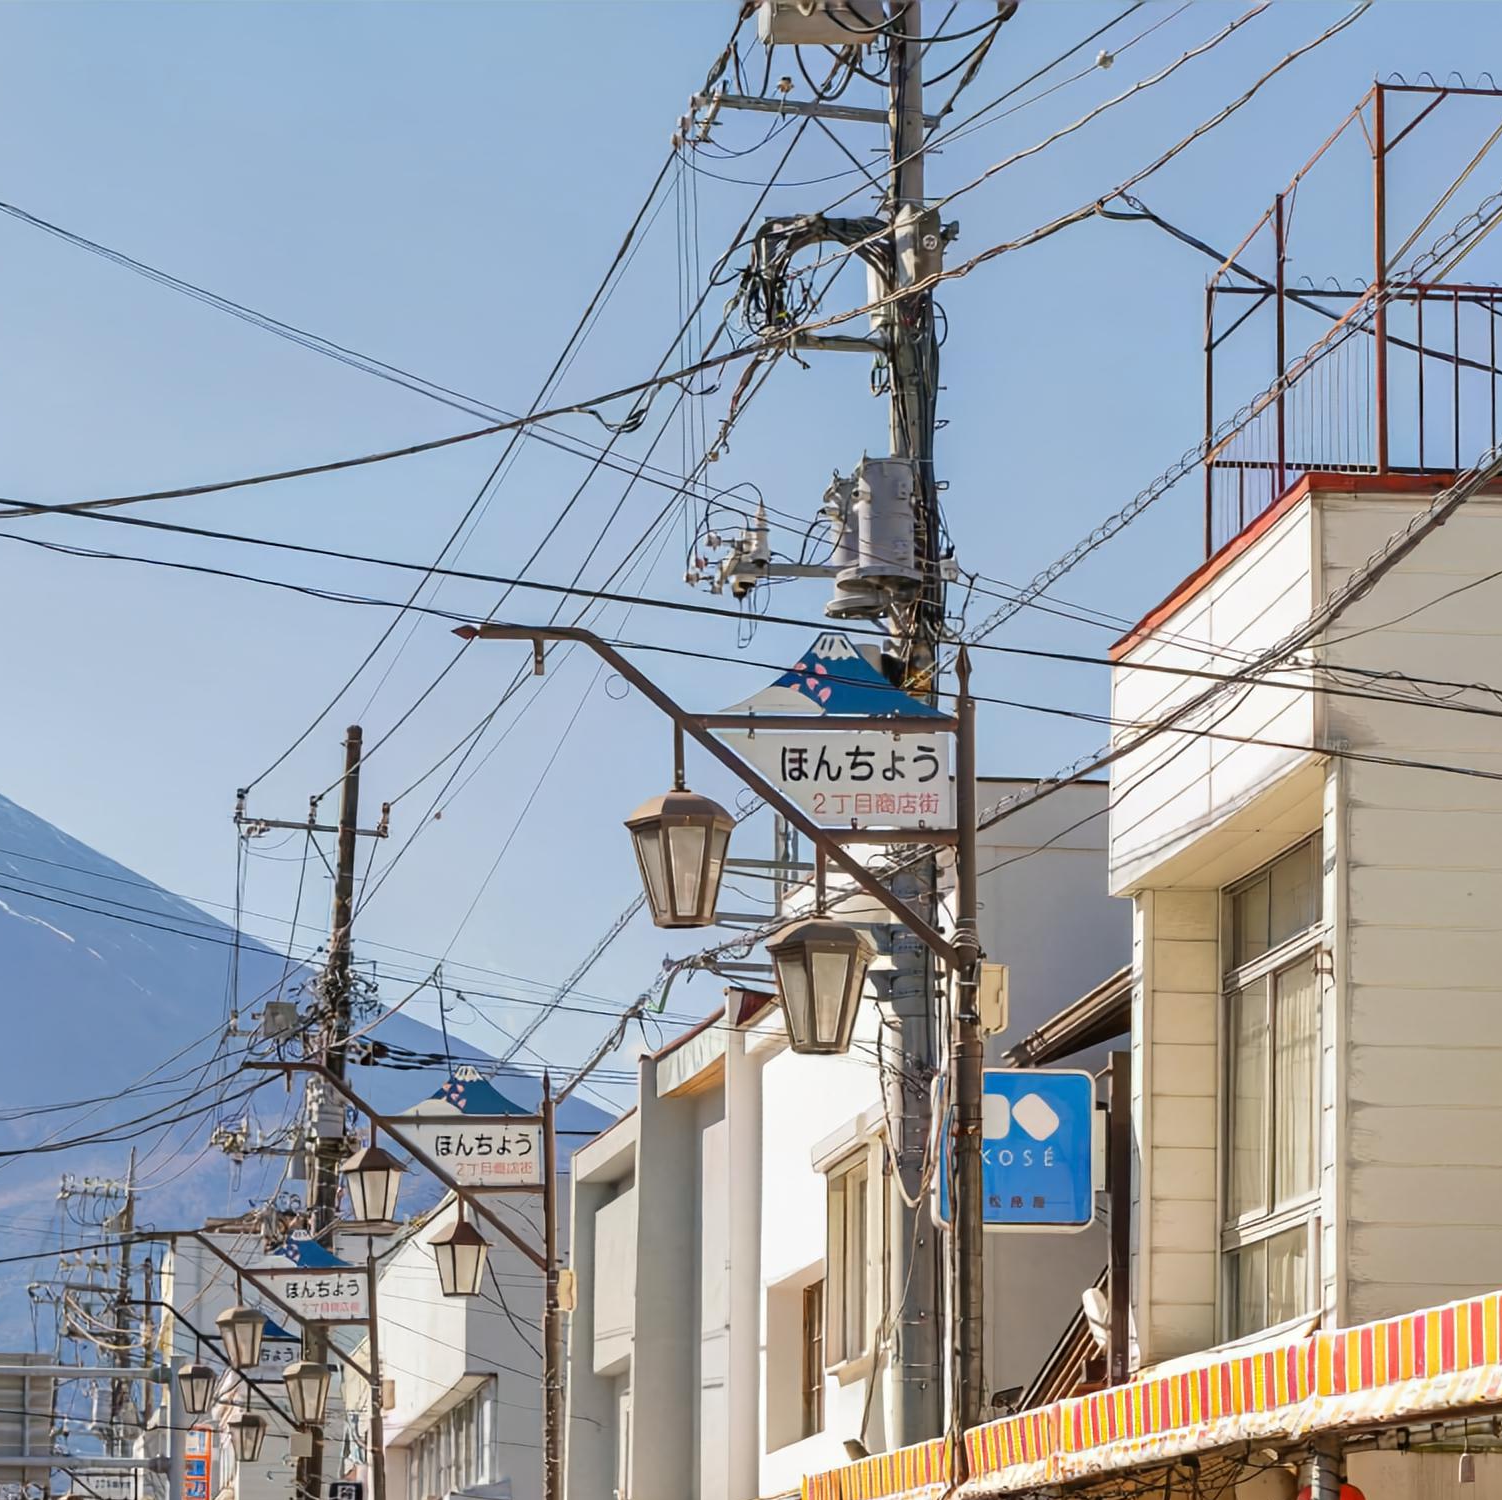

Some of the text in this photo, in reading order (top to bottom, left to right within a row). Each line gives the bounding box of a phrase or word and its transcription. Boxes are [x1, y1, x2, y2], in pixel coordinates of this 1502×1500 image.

[781, 745, 940, 783] ほんちょう
[813, 792, 940, 815] 2丁目商店街
[435, 1133, 532, 1156] ほんちょう
[980, 1147, 1054, 1167] KOSÉ
[286, 1279, 360, 1298] ほんちょう
